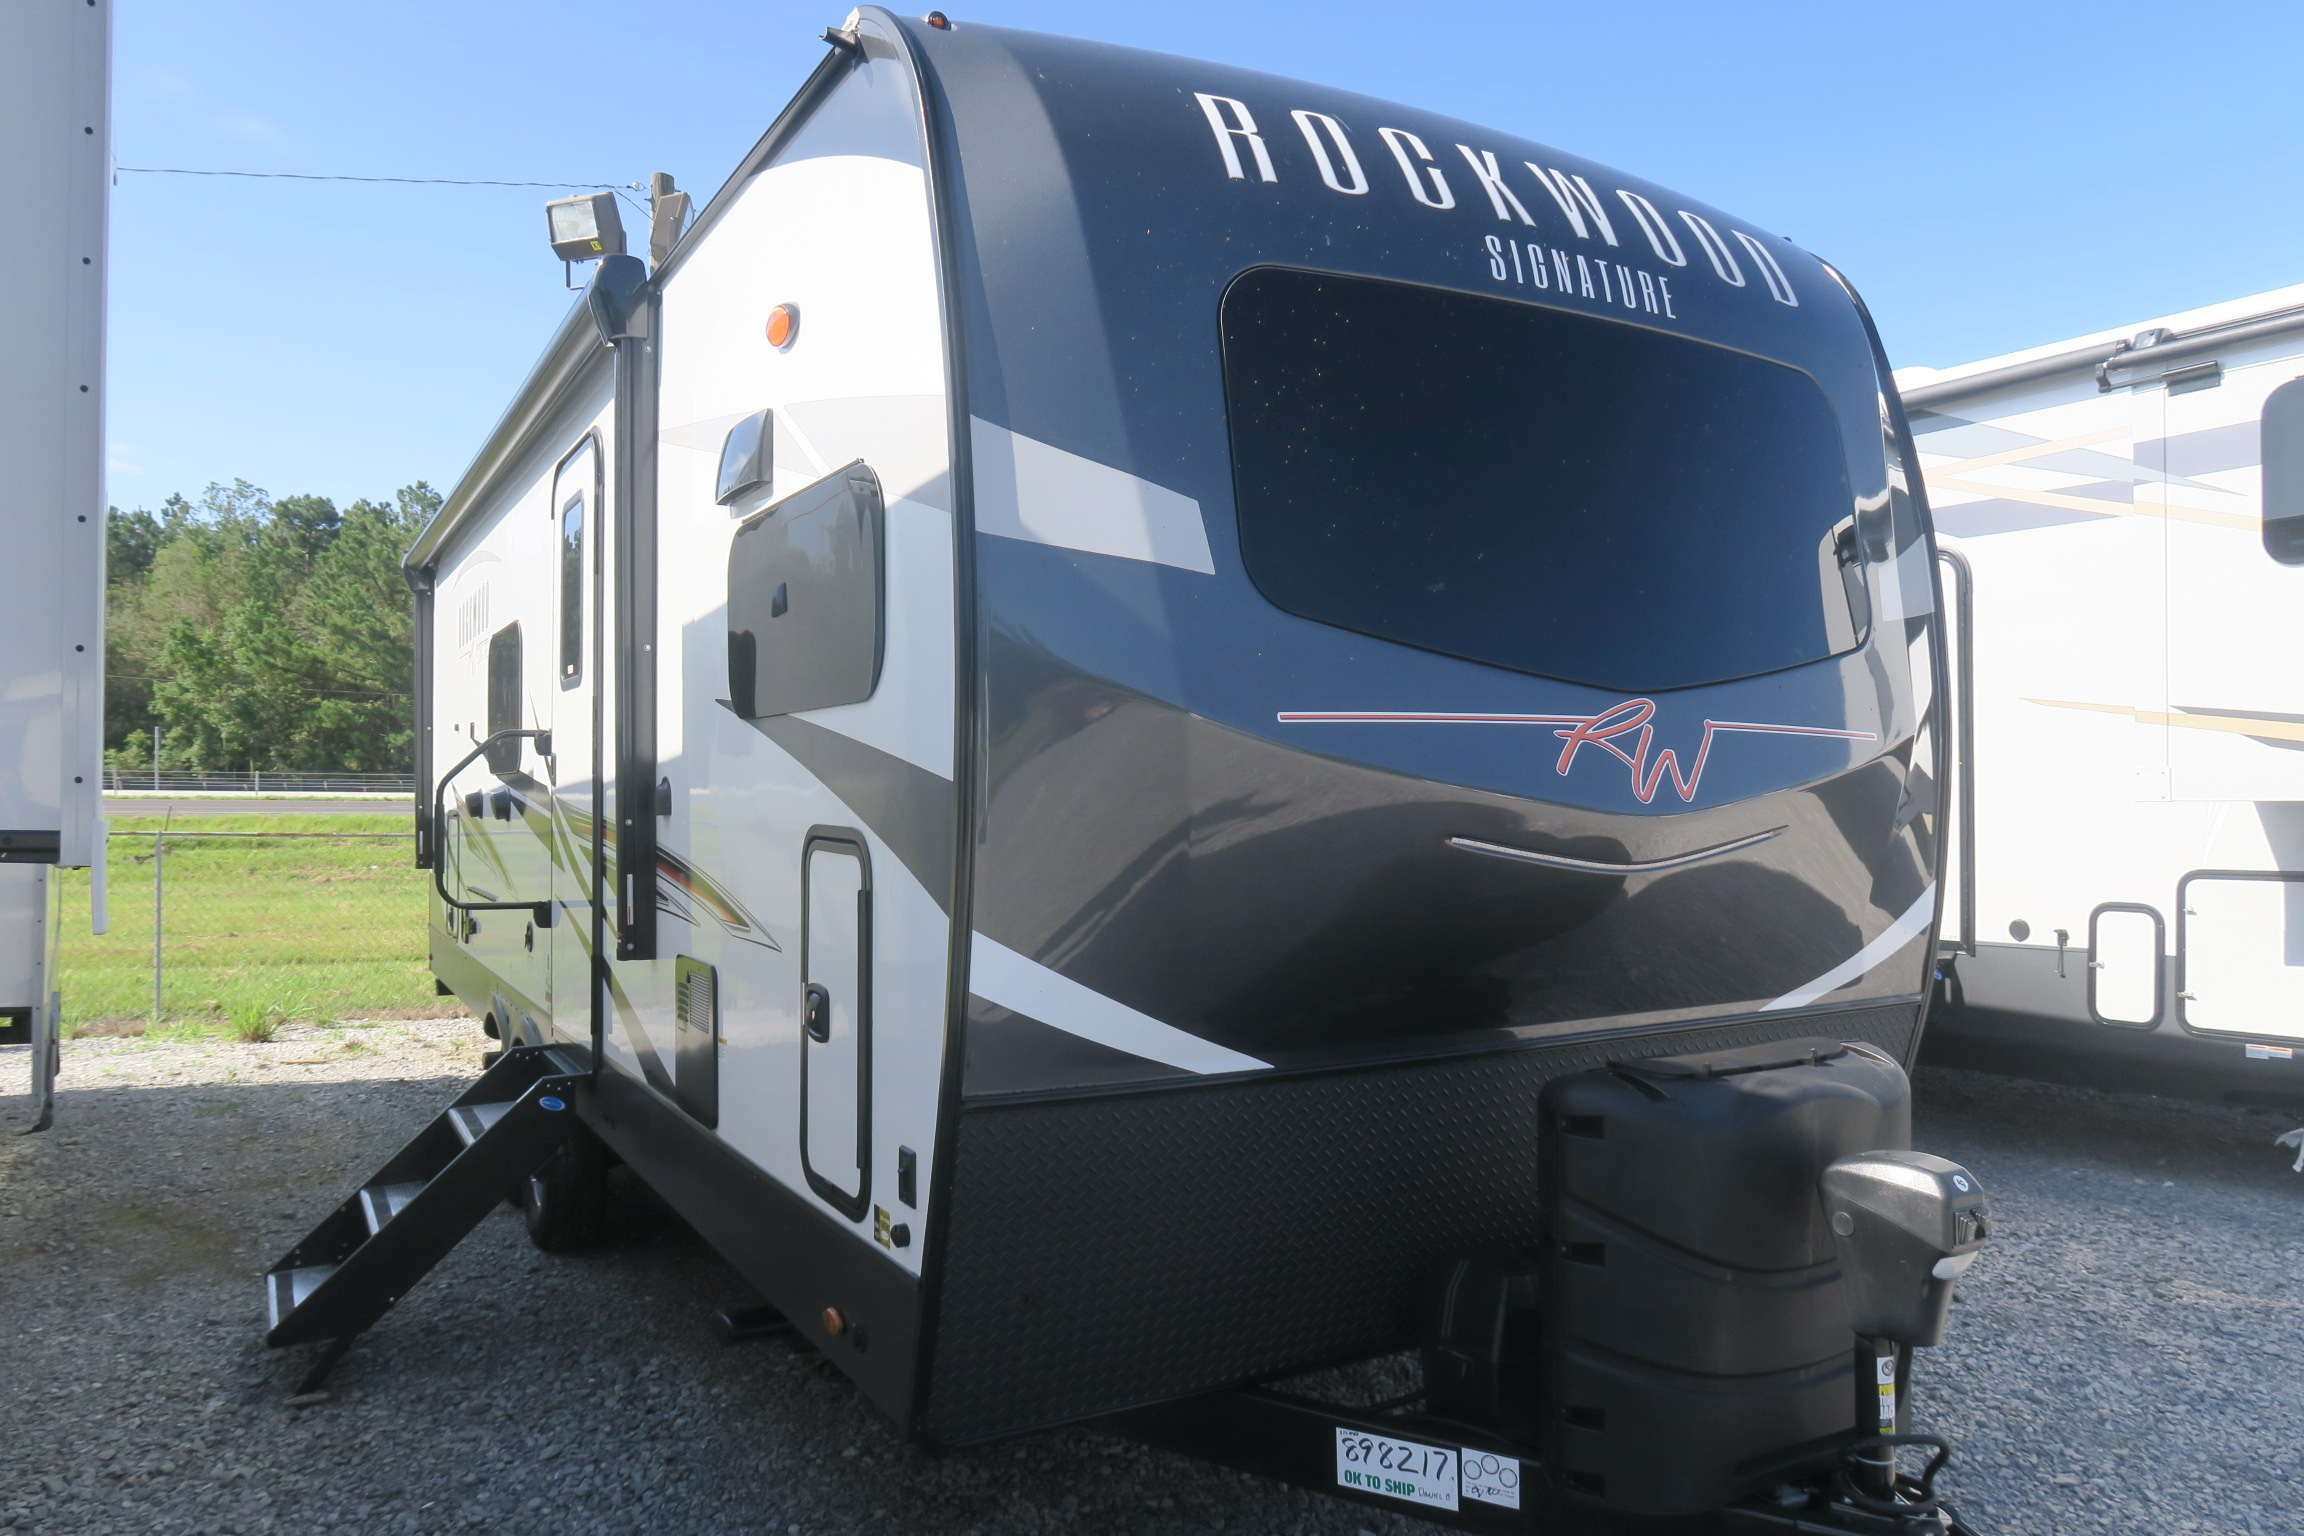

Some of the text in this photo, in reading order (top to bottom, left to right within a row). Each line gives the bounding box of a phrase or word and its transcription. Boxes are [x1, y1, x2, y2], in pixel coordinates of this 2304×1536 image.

[1193, 92, 1799, 308] ROCKWOOD
[1484, 234, 1677, 319] SIGNATURE
[1340, 1437, 1449, 1481] 898217
[1344, 1469, 1416, 1497] OK TO SHIP
